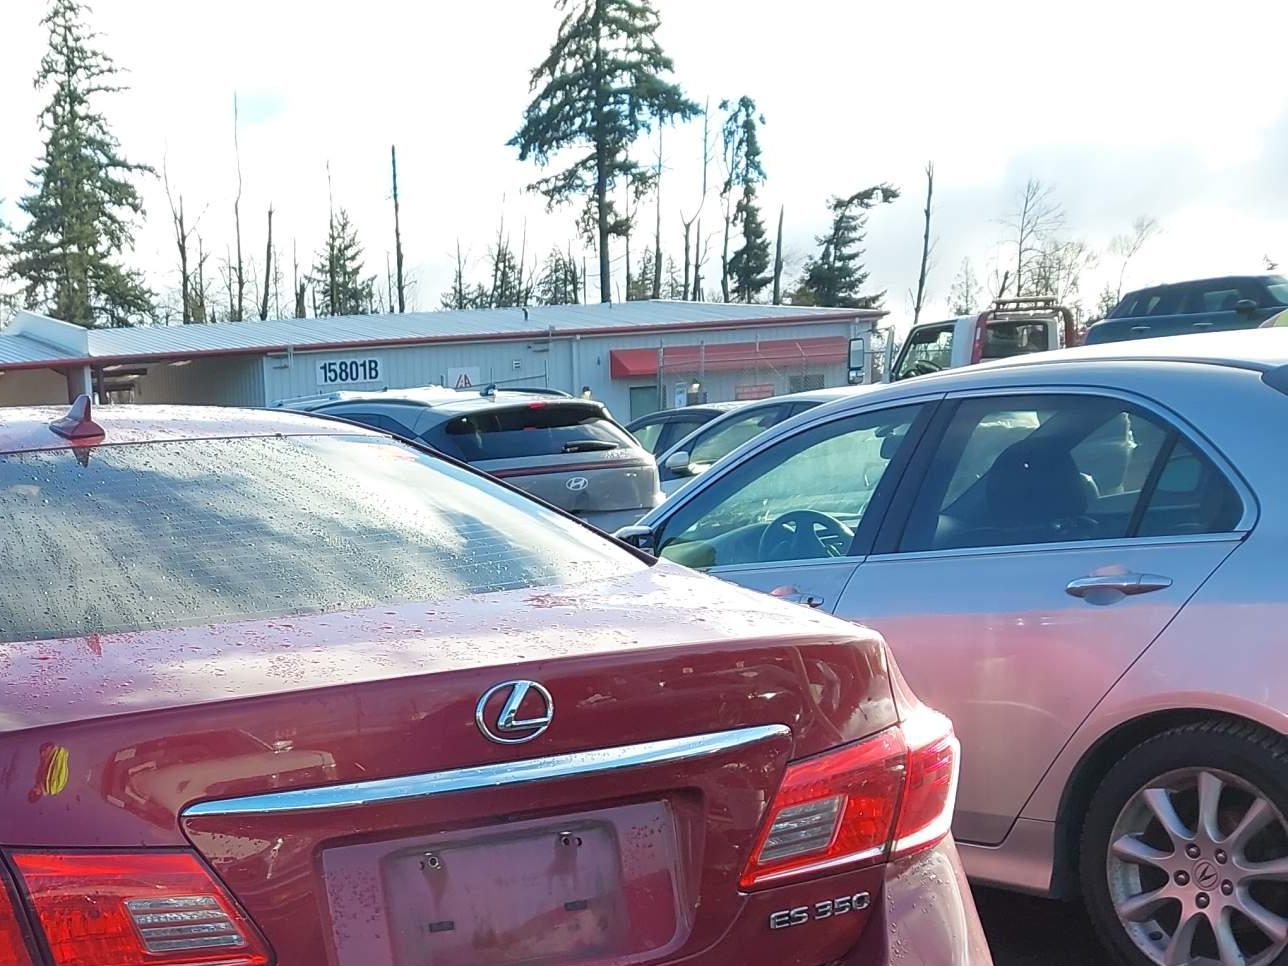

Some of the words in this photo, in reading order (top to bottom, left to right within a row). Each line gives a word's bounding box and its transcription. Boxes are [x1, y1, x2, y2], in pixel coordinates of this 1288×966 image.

[320, 359, 379, 383] 15801B
[769, 906, 809, 929] ES
[814, 891, 871, 920] 350
